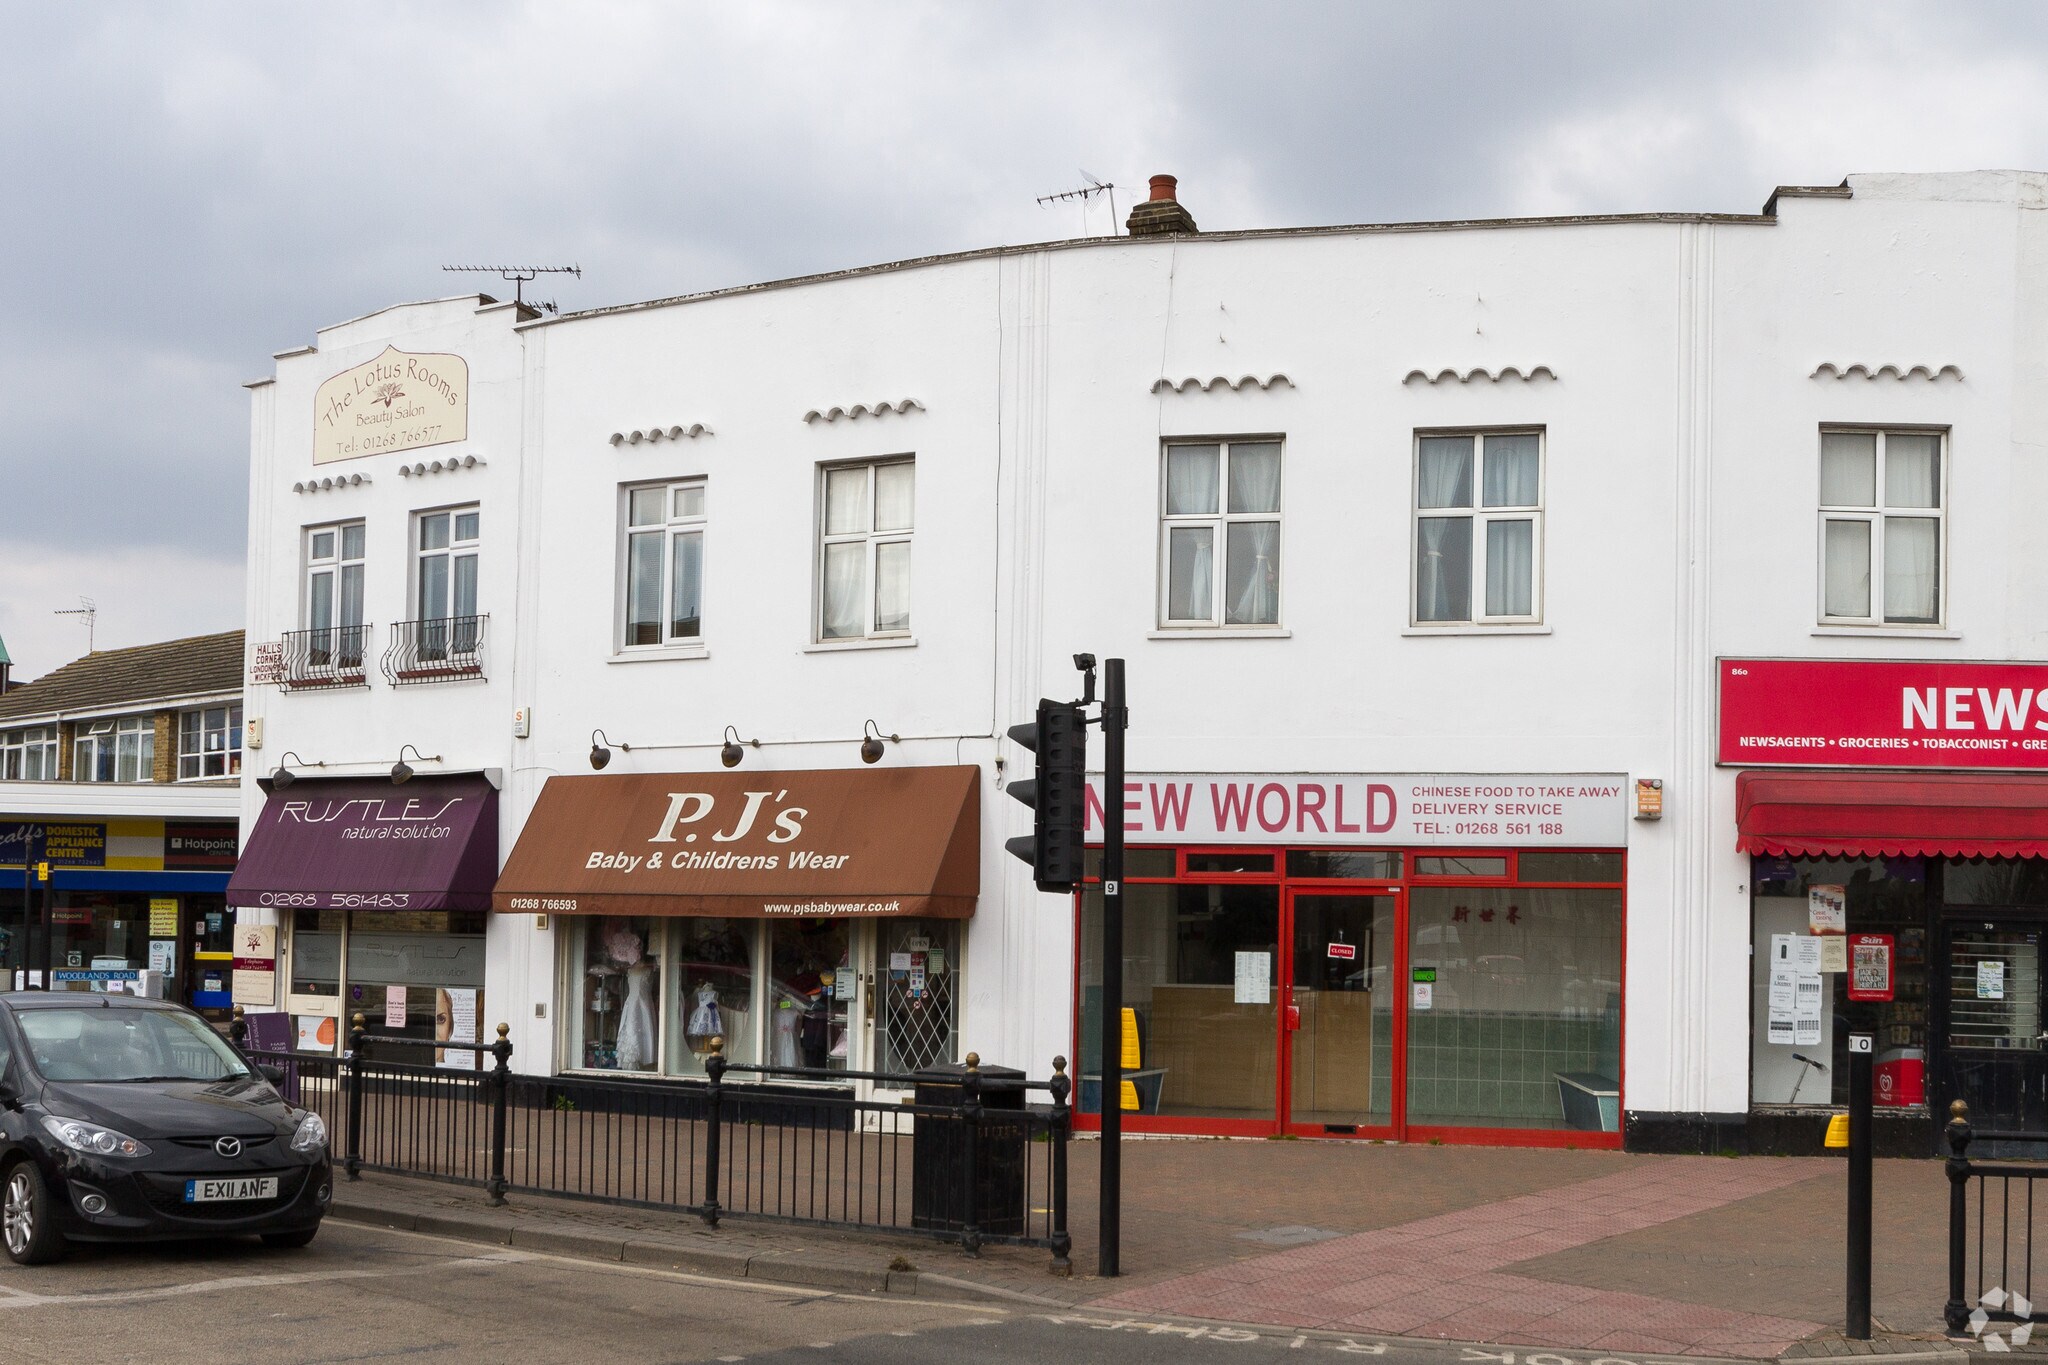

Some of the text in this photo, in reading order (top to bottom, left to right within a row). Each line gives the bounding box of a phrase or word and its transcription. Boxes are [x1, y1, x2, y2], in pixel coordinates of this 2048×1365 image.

[322, 358, 458, 428] The Lotus Rooms
[356, 401, 425, 429] Beauty Salon
[336, 424, 442, 454] Tel: 01268 766577
[257, 644, 282, 655] HALL'S
[1903, 687, 2048, 731] NEWS
[1739, 736, 1826, 748] NEWSAGENTS
[1838, 737, 1910, 749] GROCERIES
[1921, 738, 2008, 750] TOBACCONIST
[1412, 786, 1620, 798] CHINESE FOOD TO TAKE AWAY
[278, 798, 463, 823] RUSTLES
[1083, 782, 1398, 834] NEW WORLD
[1411, 803, 1563, 816] DELIVERY SERVICE
[46, 826, 99, 836] DOMESTIC
[341, 823, 451, 839] natural solution
[1412, 822, 1563, 835] TEL: 01268 561 188
[46, 837, 103, 848] APPLIANCE
[184, 838, 236, 851] Hotpoint
[45, 848, 85, 858] CENTRE
[585, 850, 849, 873] Baby & Childrens Wear
[1107, 883, 1114, 893] 9
[260, 892, 409, 907] 01268 561483
[510, 897, 578, 911] 01268 766593
[763, 900, 900, 915] www.pjsbabywear.co.uk
[1860, 936, 1883, 944] Sun
[366, 944, 466, 959] RUSTLES
[58, 971, 136, 980] WOODLANDS ROAD
[204, 1181, 269, 1198] EX11 ANF
[1460, 1348, 1695, 1365] OOK
